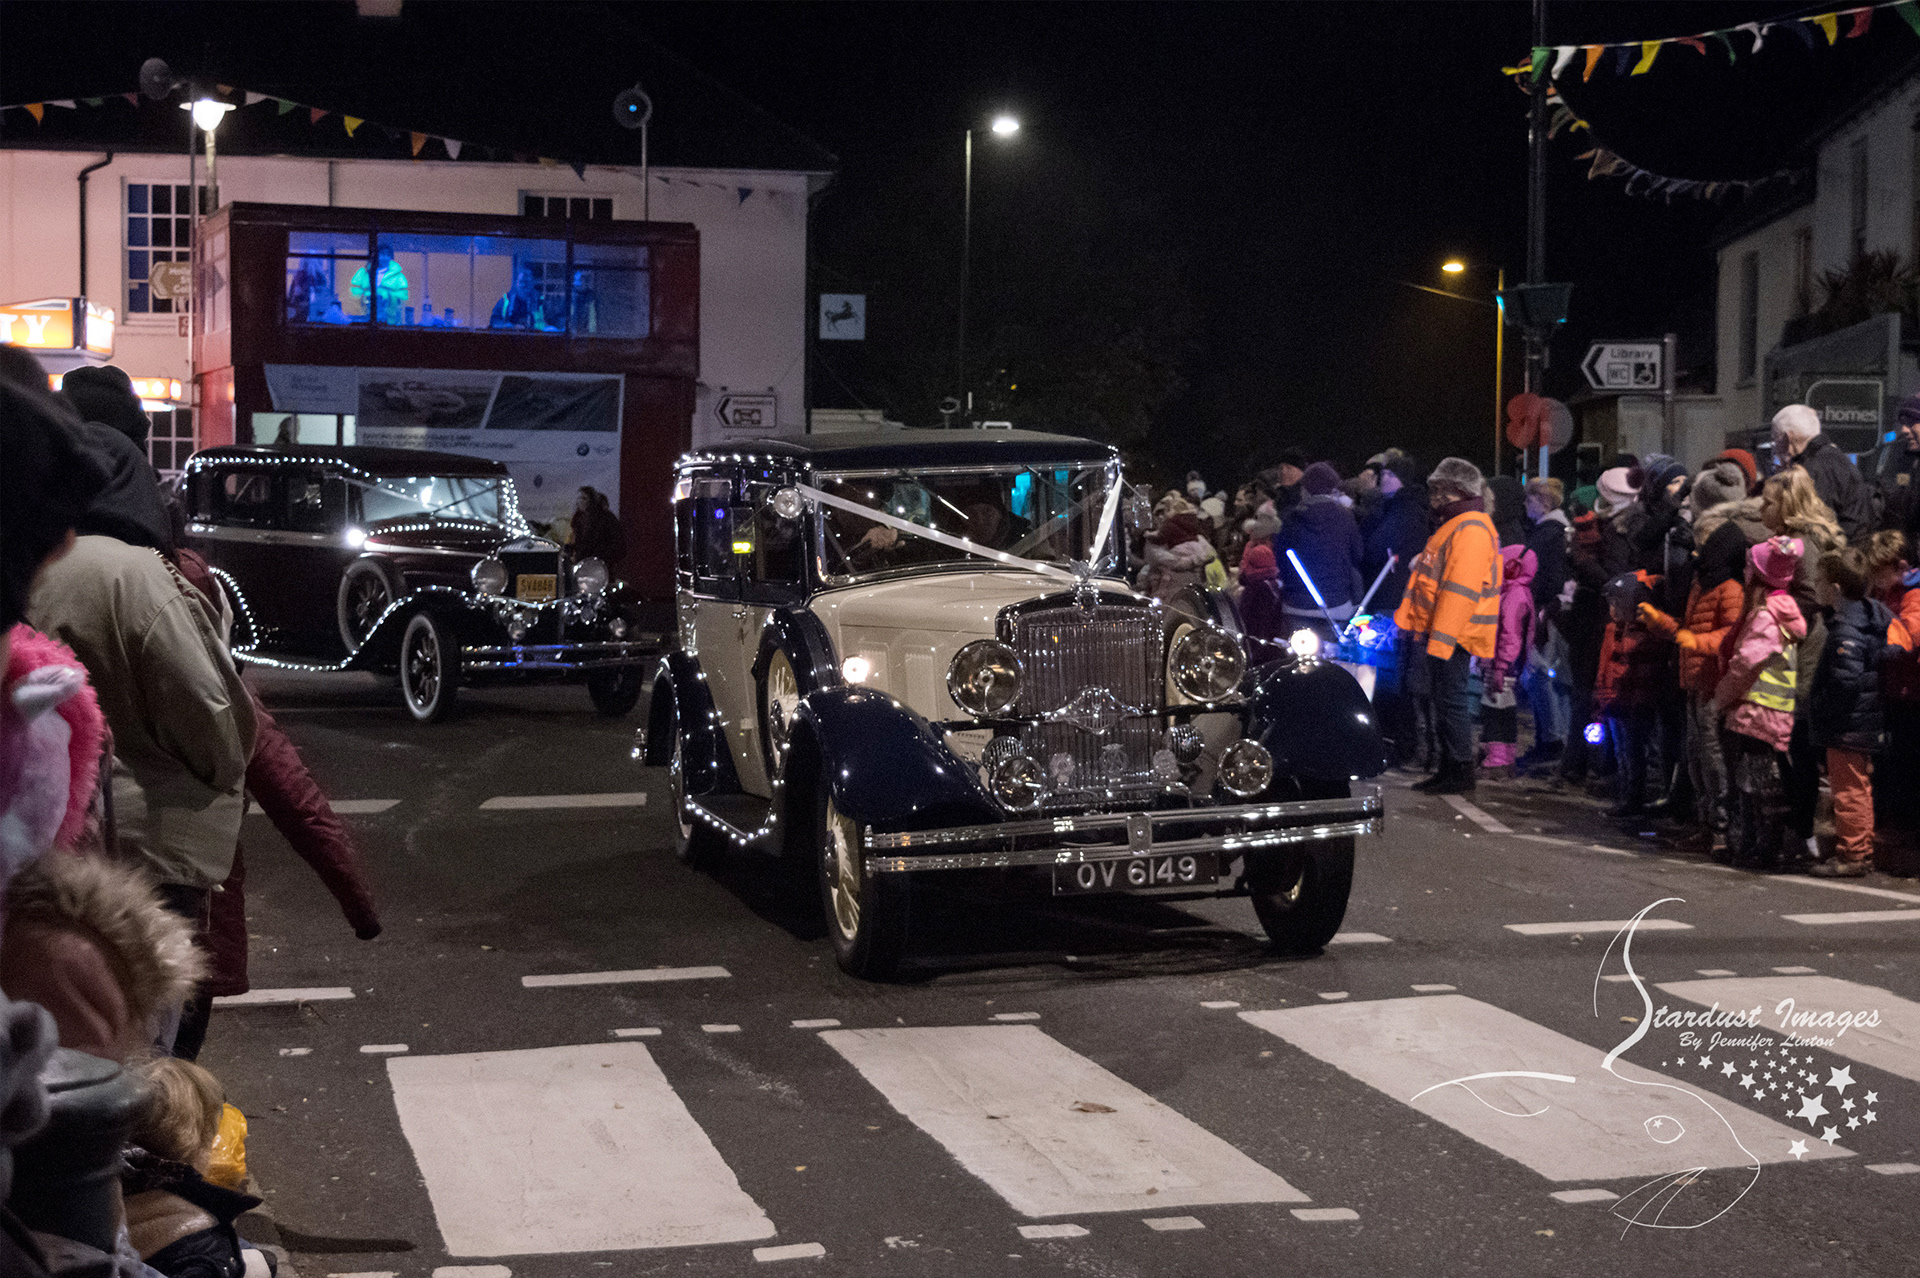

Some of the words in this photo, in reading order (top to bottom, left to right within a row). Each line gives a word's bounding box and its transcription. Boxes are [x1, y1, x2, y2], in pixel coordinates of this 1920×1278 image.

[1610, 348, 1654, 359] Library
[1609, 368, 1627, 379] WC
[1825, 405, 1878, 422] homes
[1076, 860, 1118, 889] OV
[1127, 856, 1197, 885] 6149
